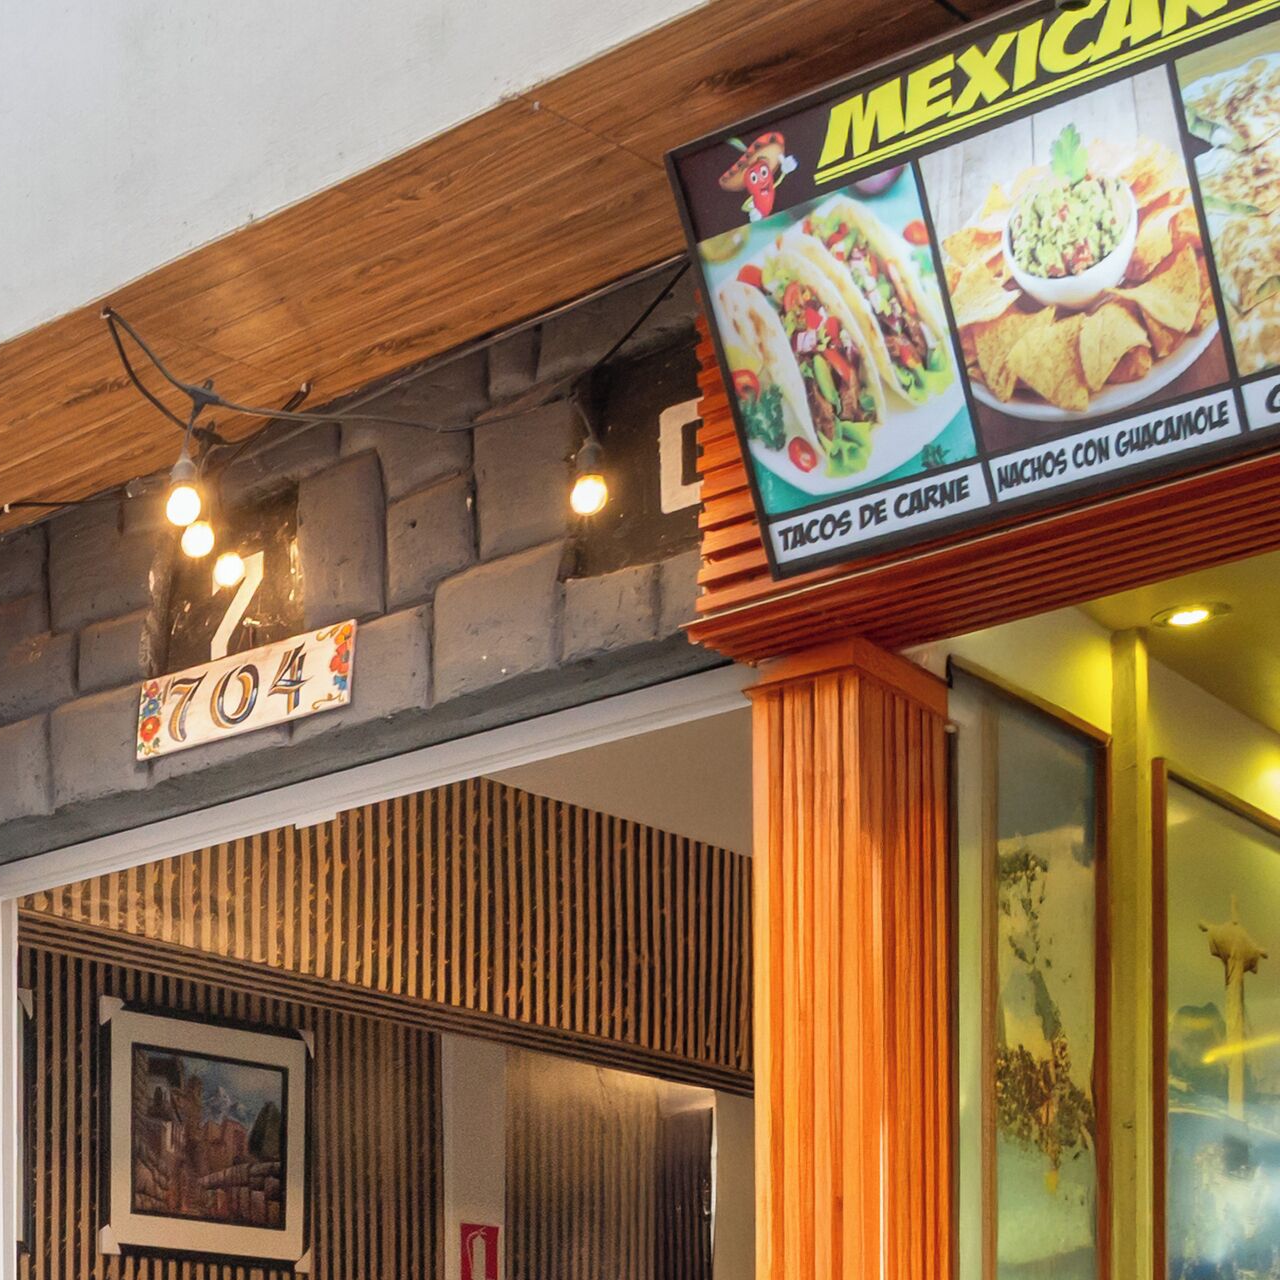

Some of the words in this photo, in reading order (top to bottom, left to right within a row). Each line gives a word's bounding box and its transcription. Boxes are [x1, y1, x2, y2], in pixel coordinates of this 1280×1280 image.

[996, 448, 1067, 492] NACHOS
[1072, 435, 1110, 469] CON
[1115, 400, 1229, 457] GUACAMOLE
[778, 509, 852, 552] TACOS
[859, 498, 887, 531] DE
[894, 475, 970, 517] CARNE
[165, 642, 314, 743] 704
